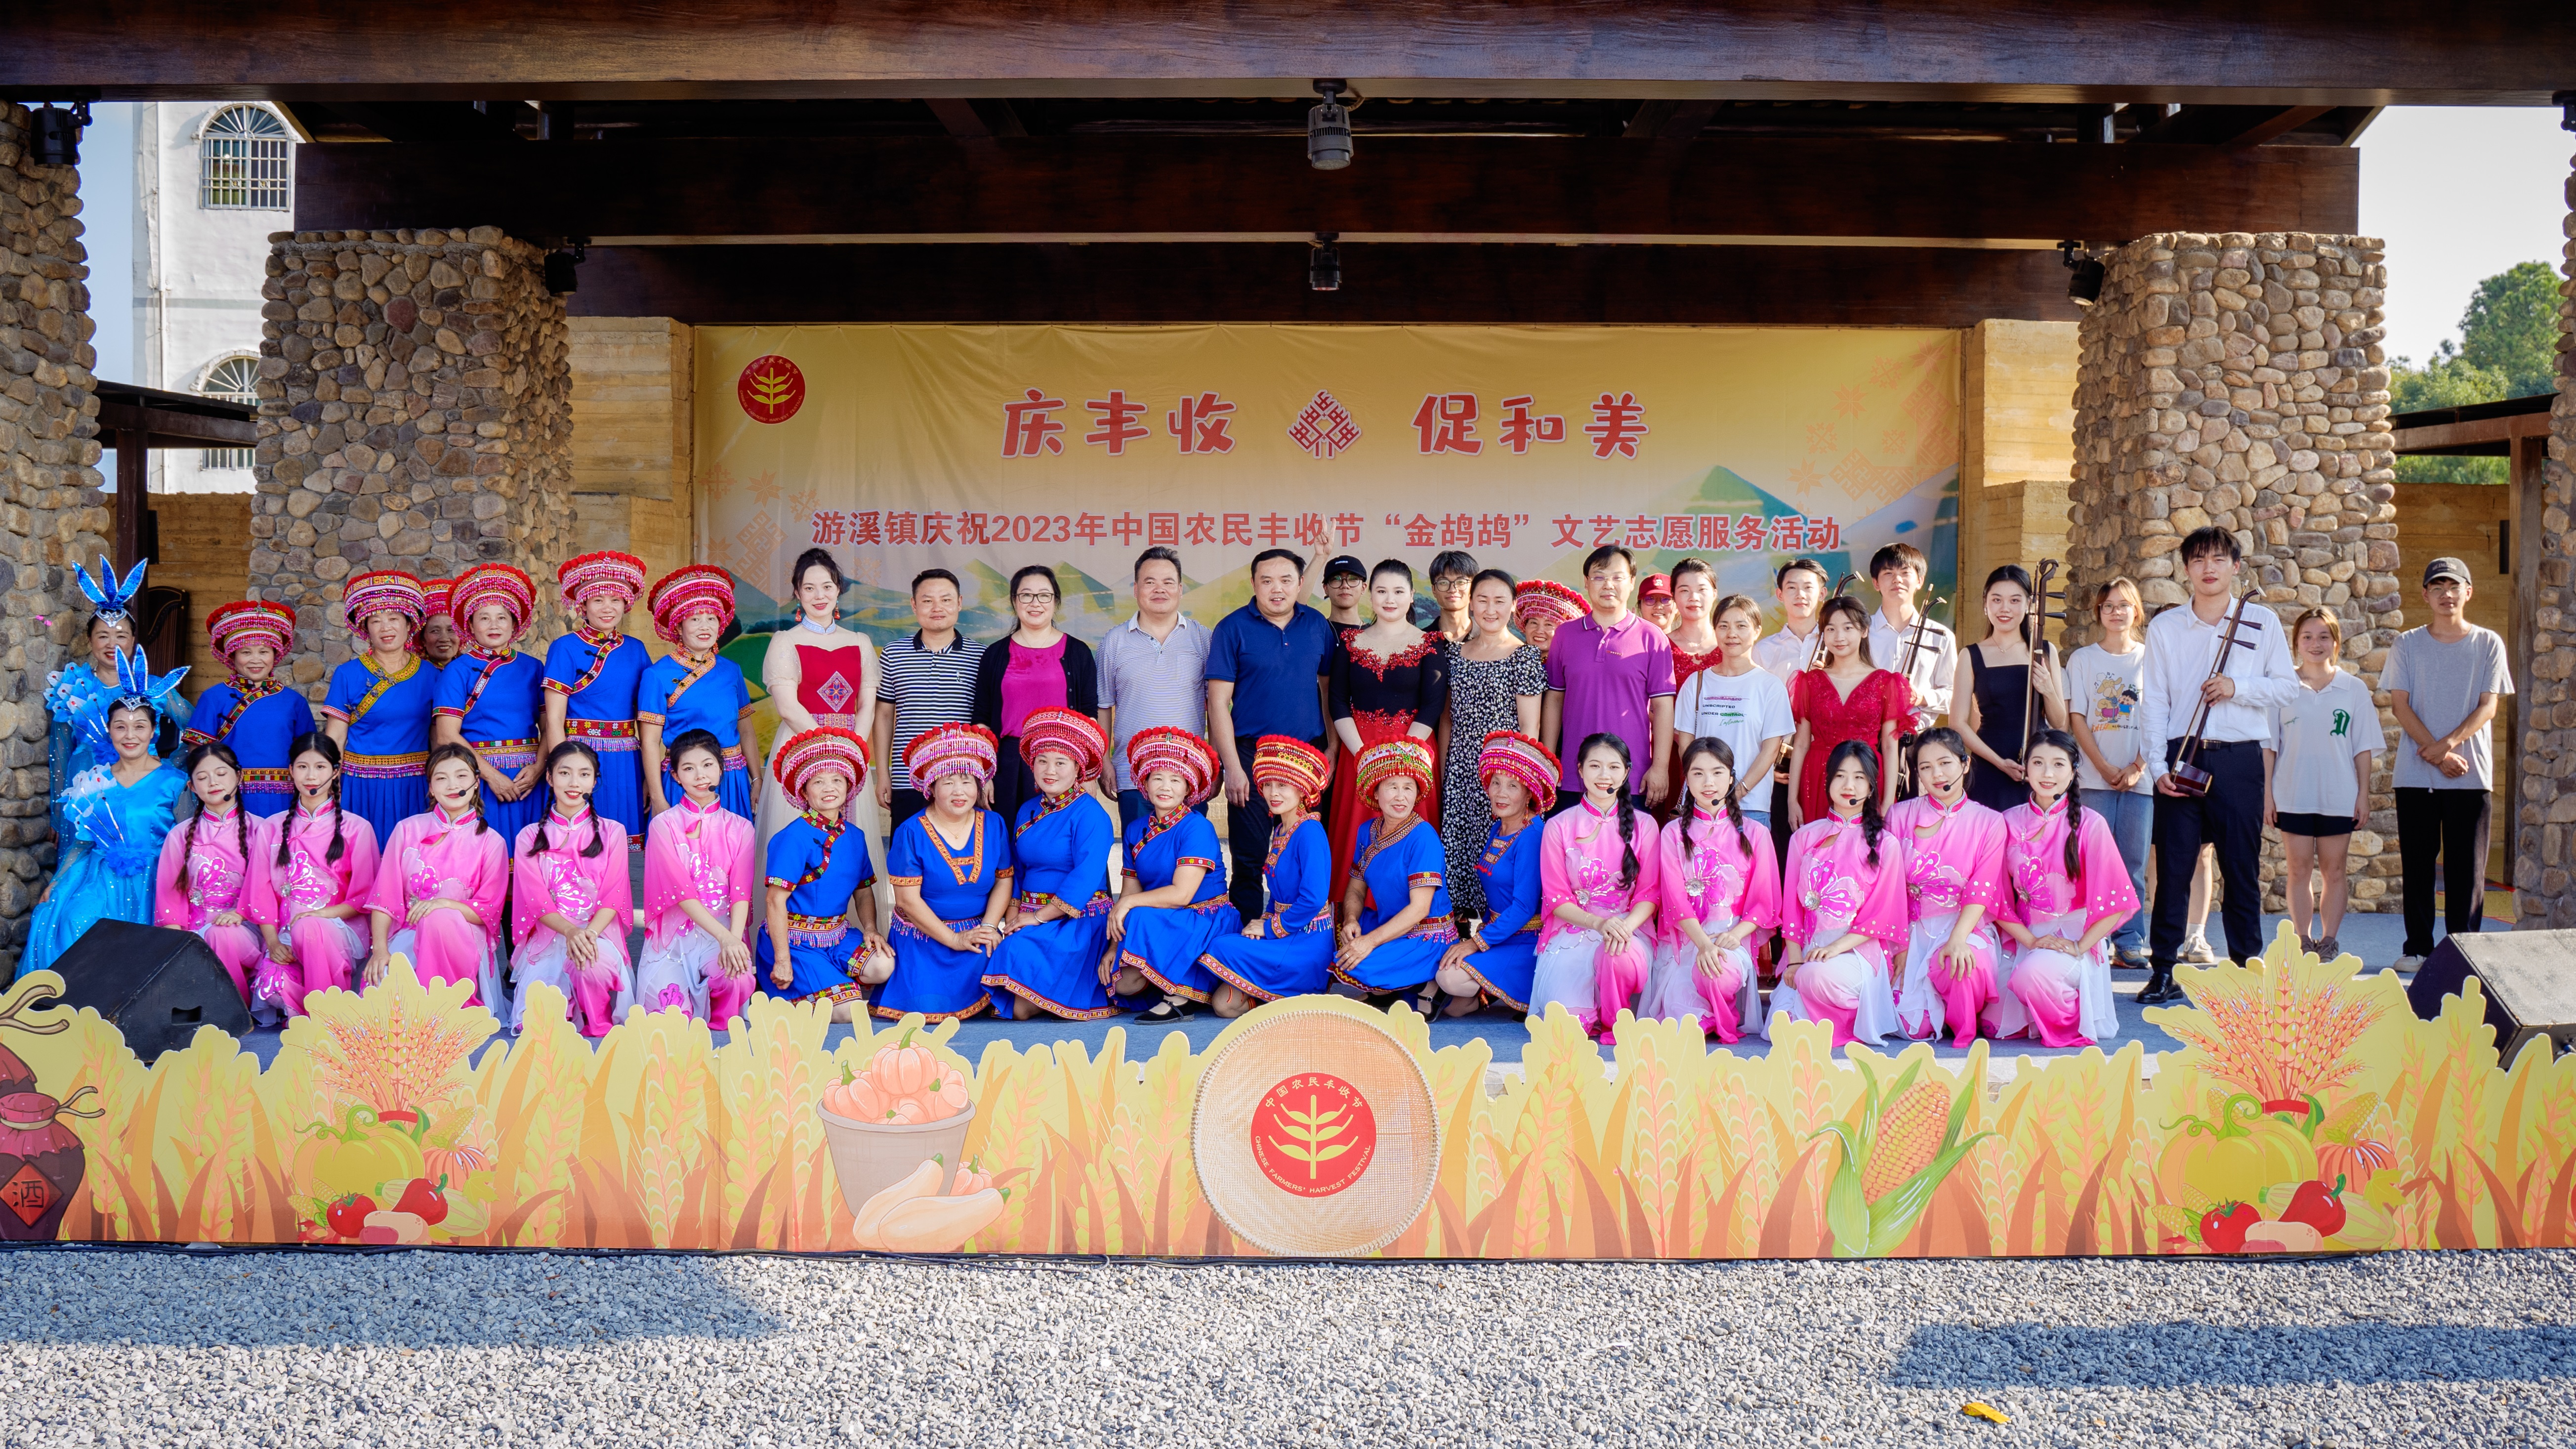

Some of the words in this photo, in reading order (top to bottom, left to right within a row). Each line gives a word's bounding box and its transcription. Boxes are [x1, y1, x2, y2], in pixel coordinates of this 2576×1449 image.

[769, 414, 789, 422] HARVEST
[790, 395, 803, 414] FESTIVAL
[1002, 388, 1236, 457] 庆丰收
[1411, 392, 1649, 458] 促和美
[1265, 1076, 1363, 1108] 中国农民丰收节
[1254, 1135, 1269, 1168] CHINESE
[1309, 1178, 1345, 1193] HARVEST
[1347, 1145, 1371, 1180] FESTIVAL
[12, 1180, 44, 1208] 酒
